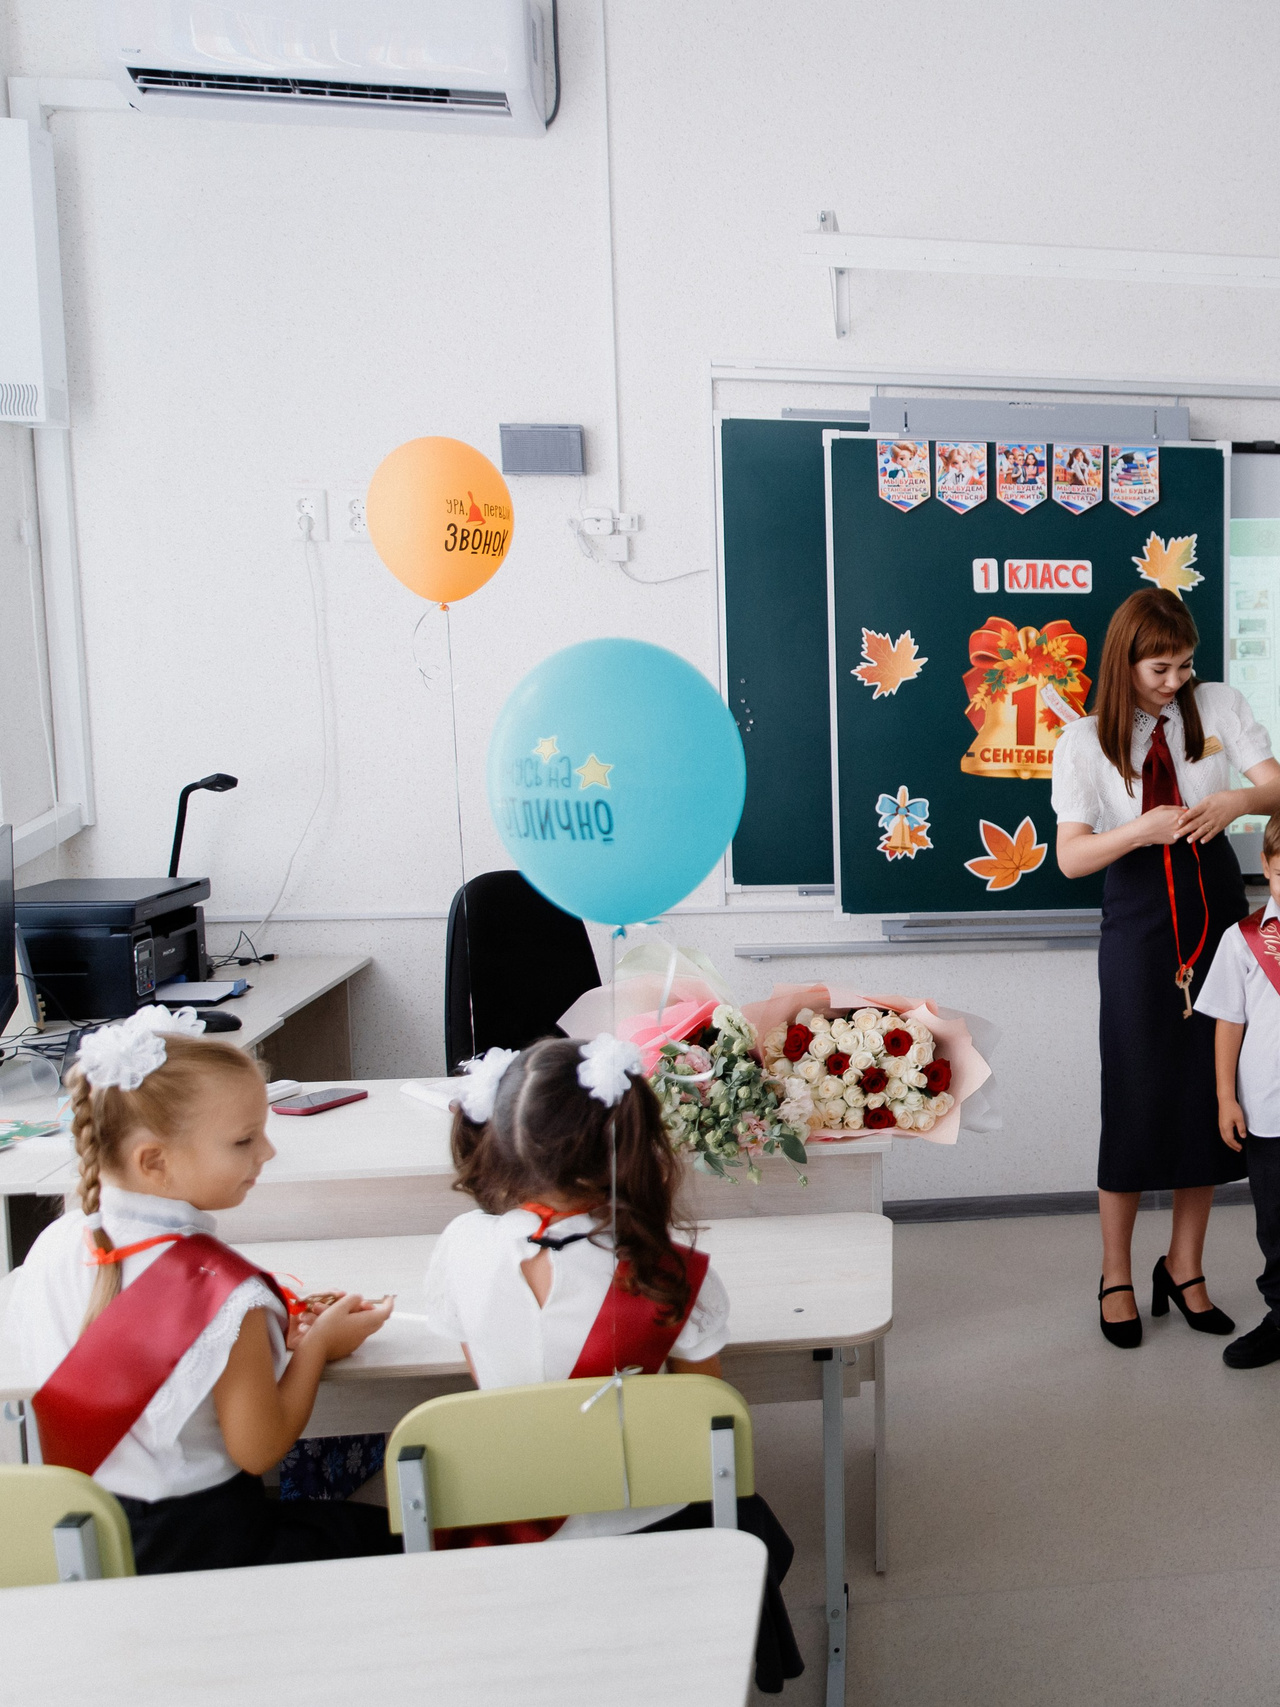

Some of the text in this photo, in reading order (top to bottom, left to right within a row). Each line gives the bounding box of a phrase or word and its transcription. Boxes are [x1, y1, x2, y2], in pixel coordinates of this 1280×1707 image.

[446, 499, 468, 516] УРА,
[445, 523, 508, 556] ЗВОНОК
[981, 562, 1088, 589] 1 КЛАСС
[1012, 684, 1037, 746] 1
